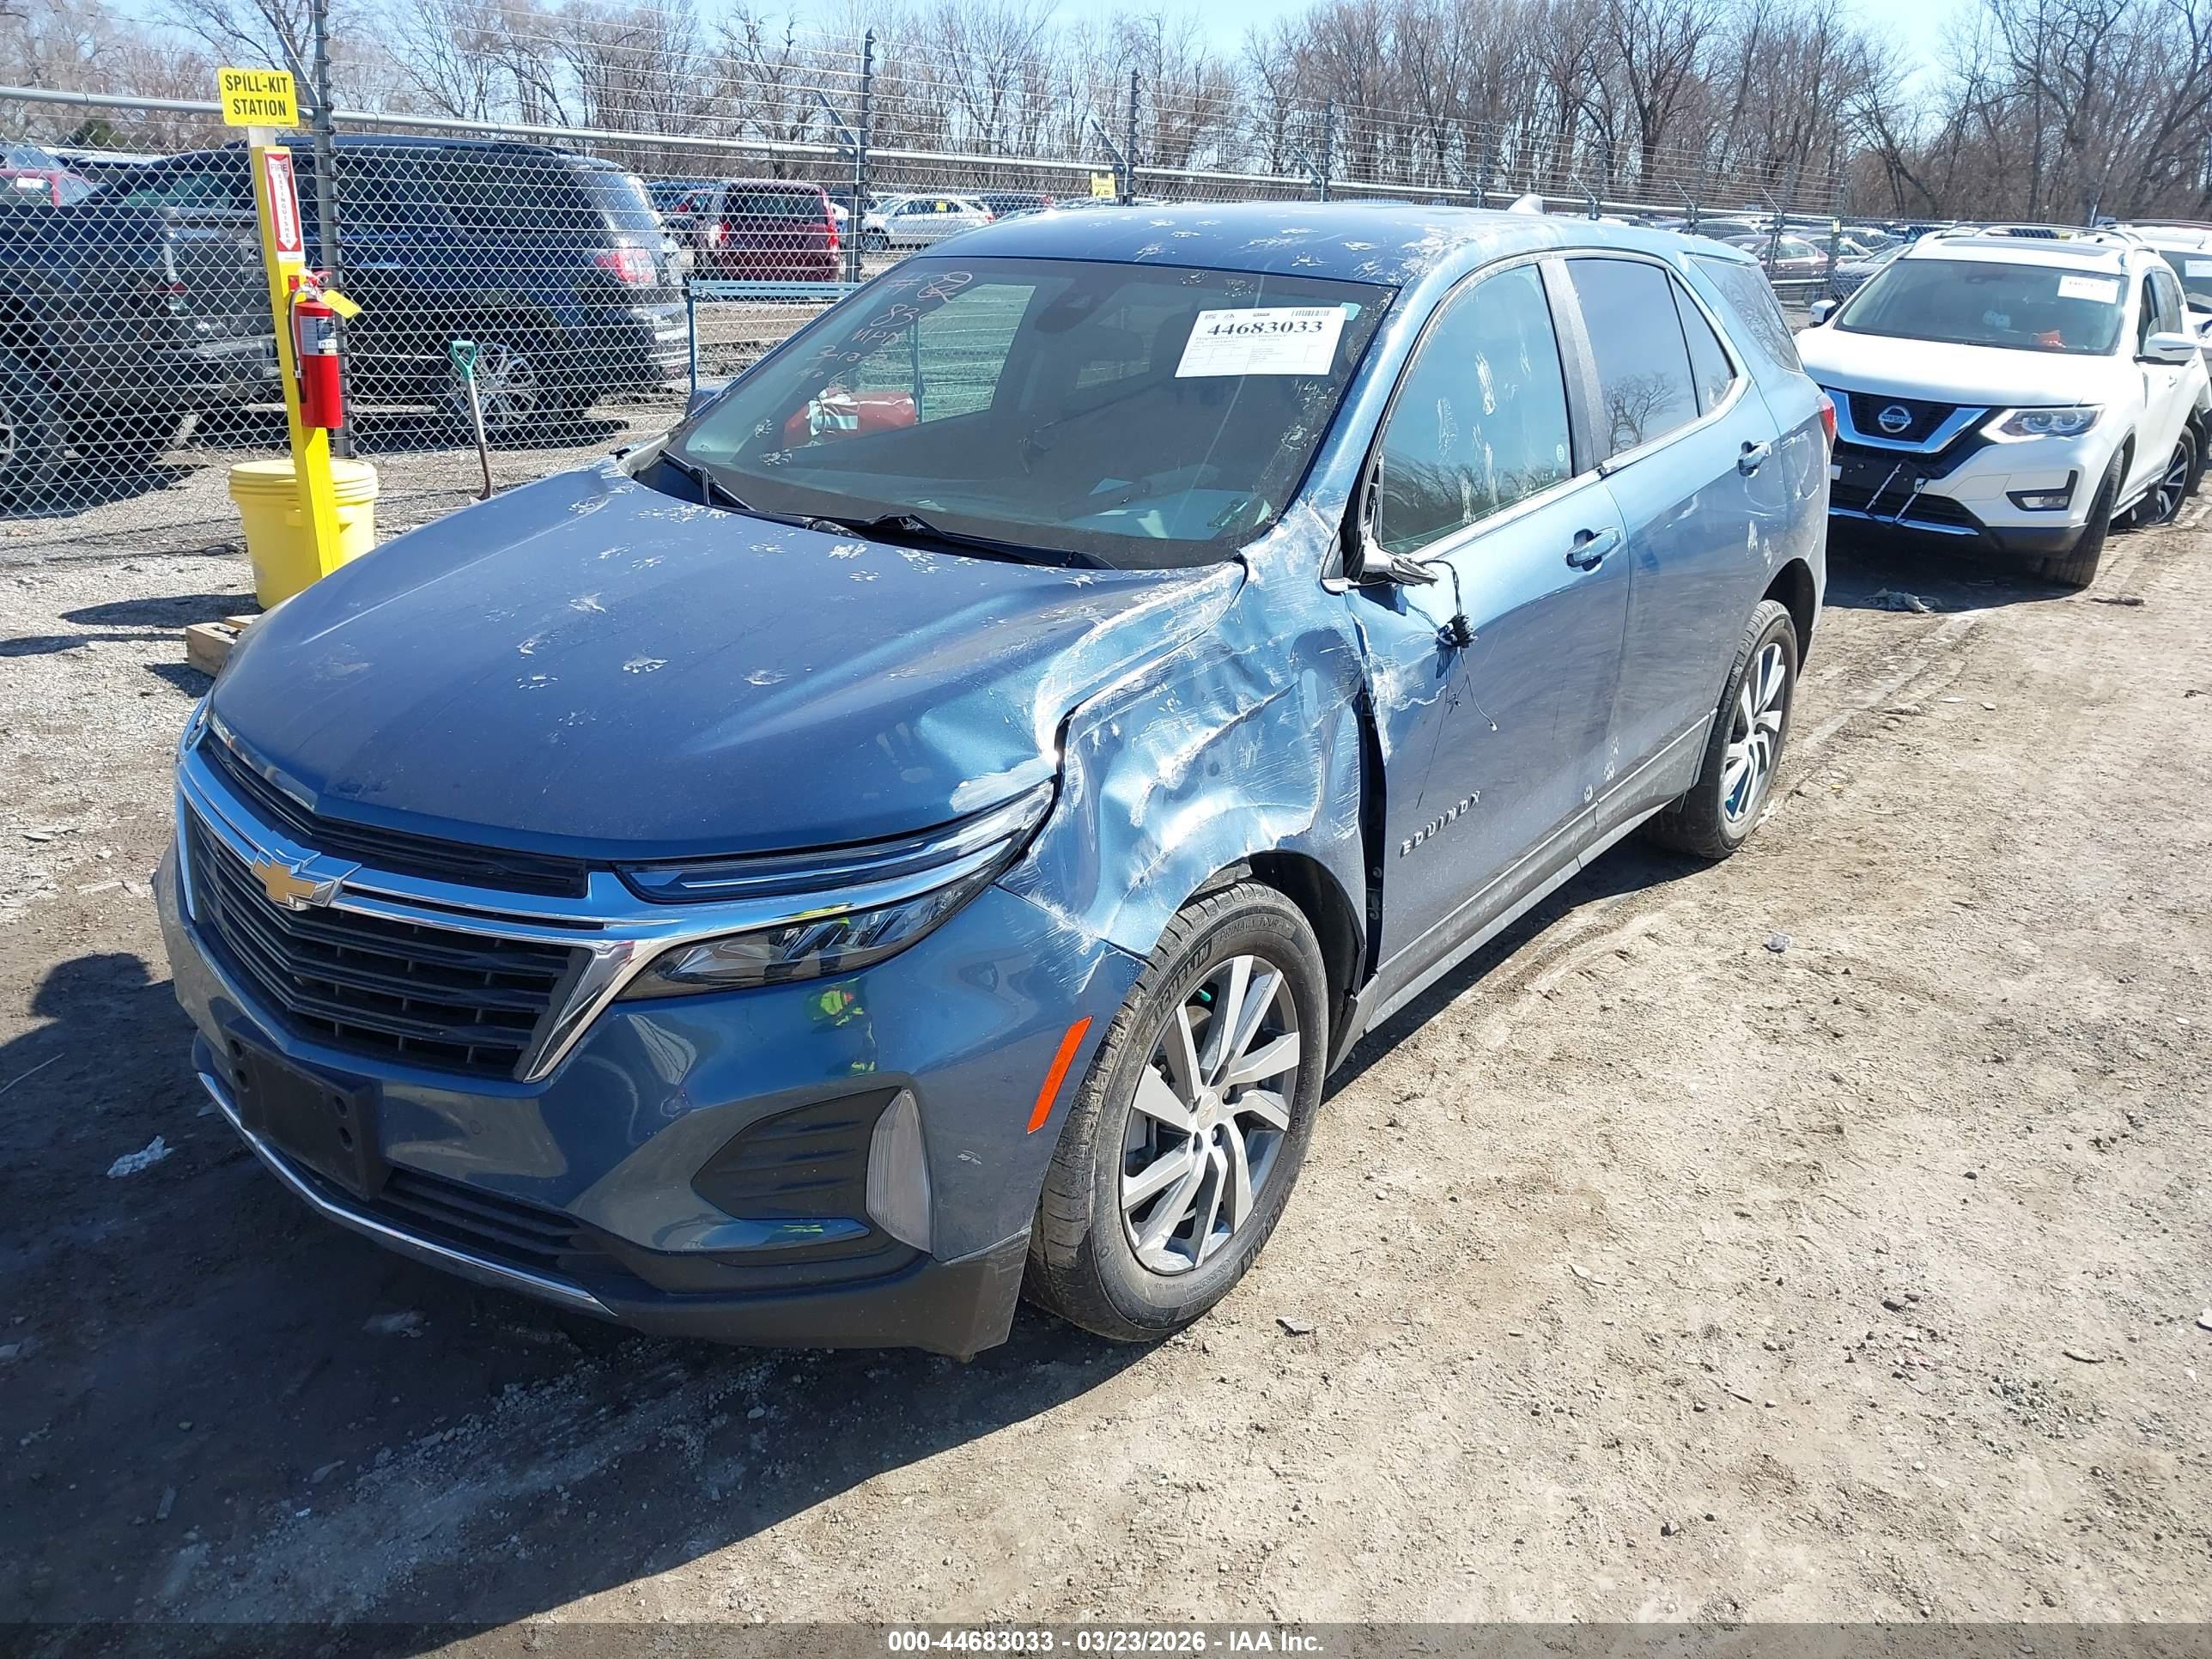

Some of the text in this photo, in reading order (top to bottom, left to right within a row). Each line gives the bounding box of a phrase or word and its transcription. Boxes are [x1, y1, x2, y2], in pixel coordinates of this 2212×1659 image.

[225, 74, 288, 93] SPILL-KIT
[233, 98, 287, 117] STATION
[270, 163, 289, 173] FIRE
[277, 173, 292, 244] EXTINGUISHER
[1207, 321, 1322, 335] 44683033
[1400, 790, 1480, 859] EQUINOX
